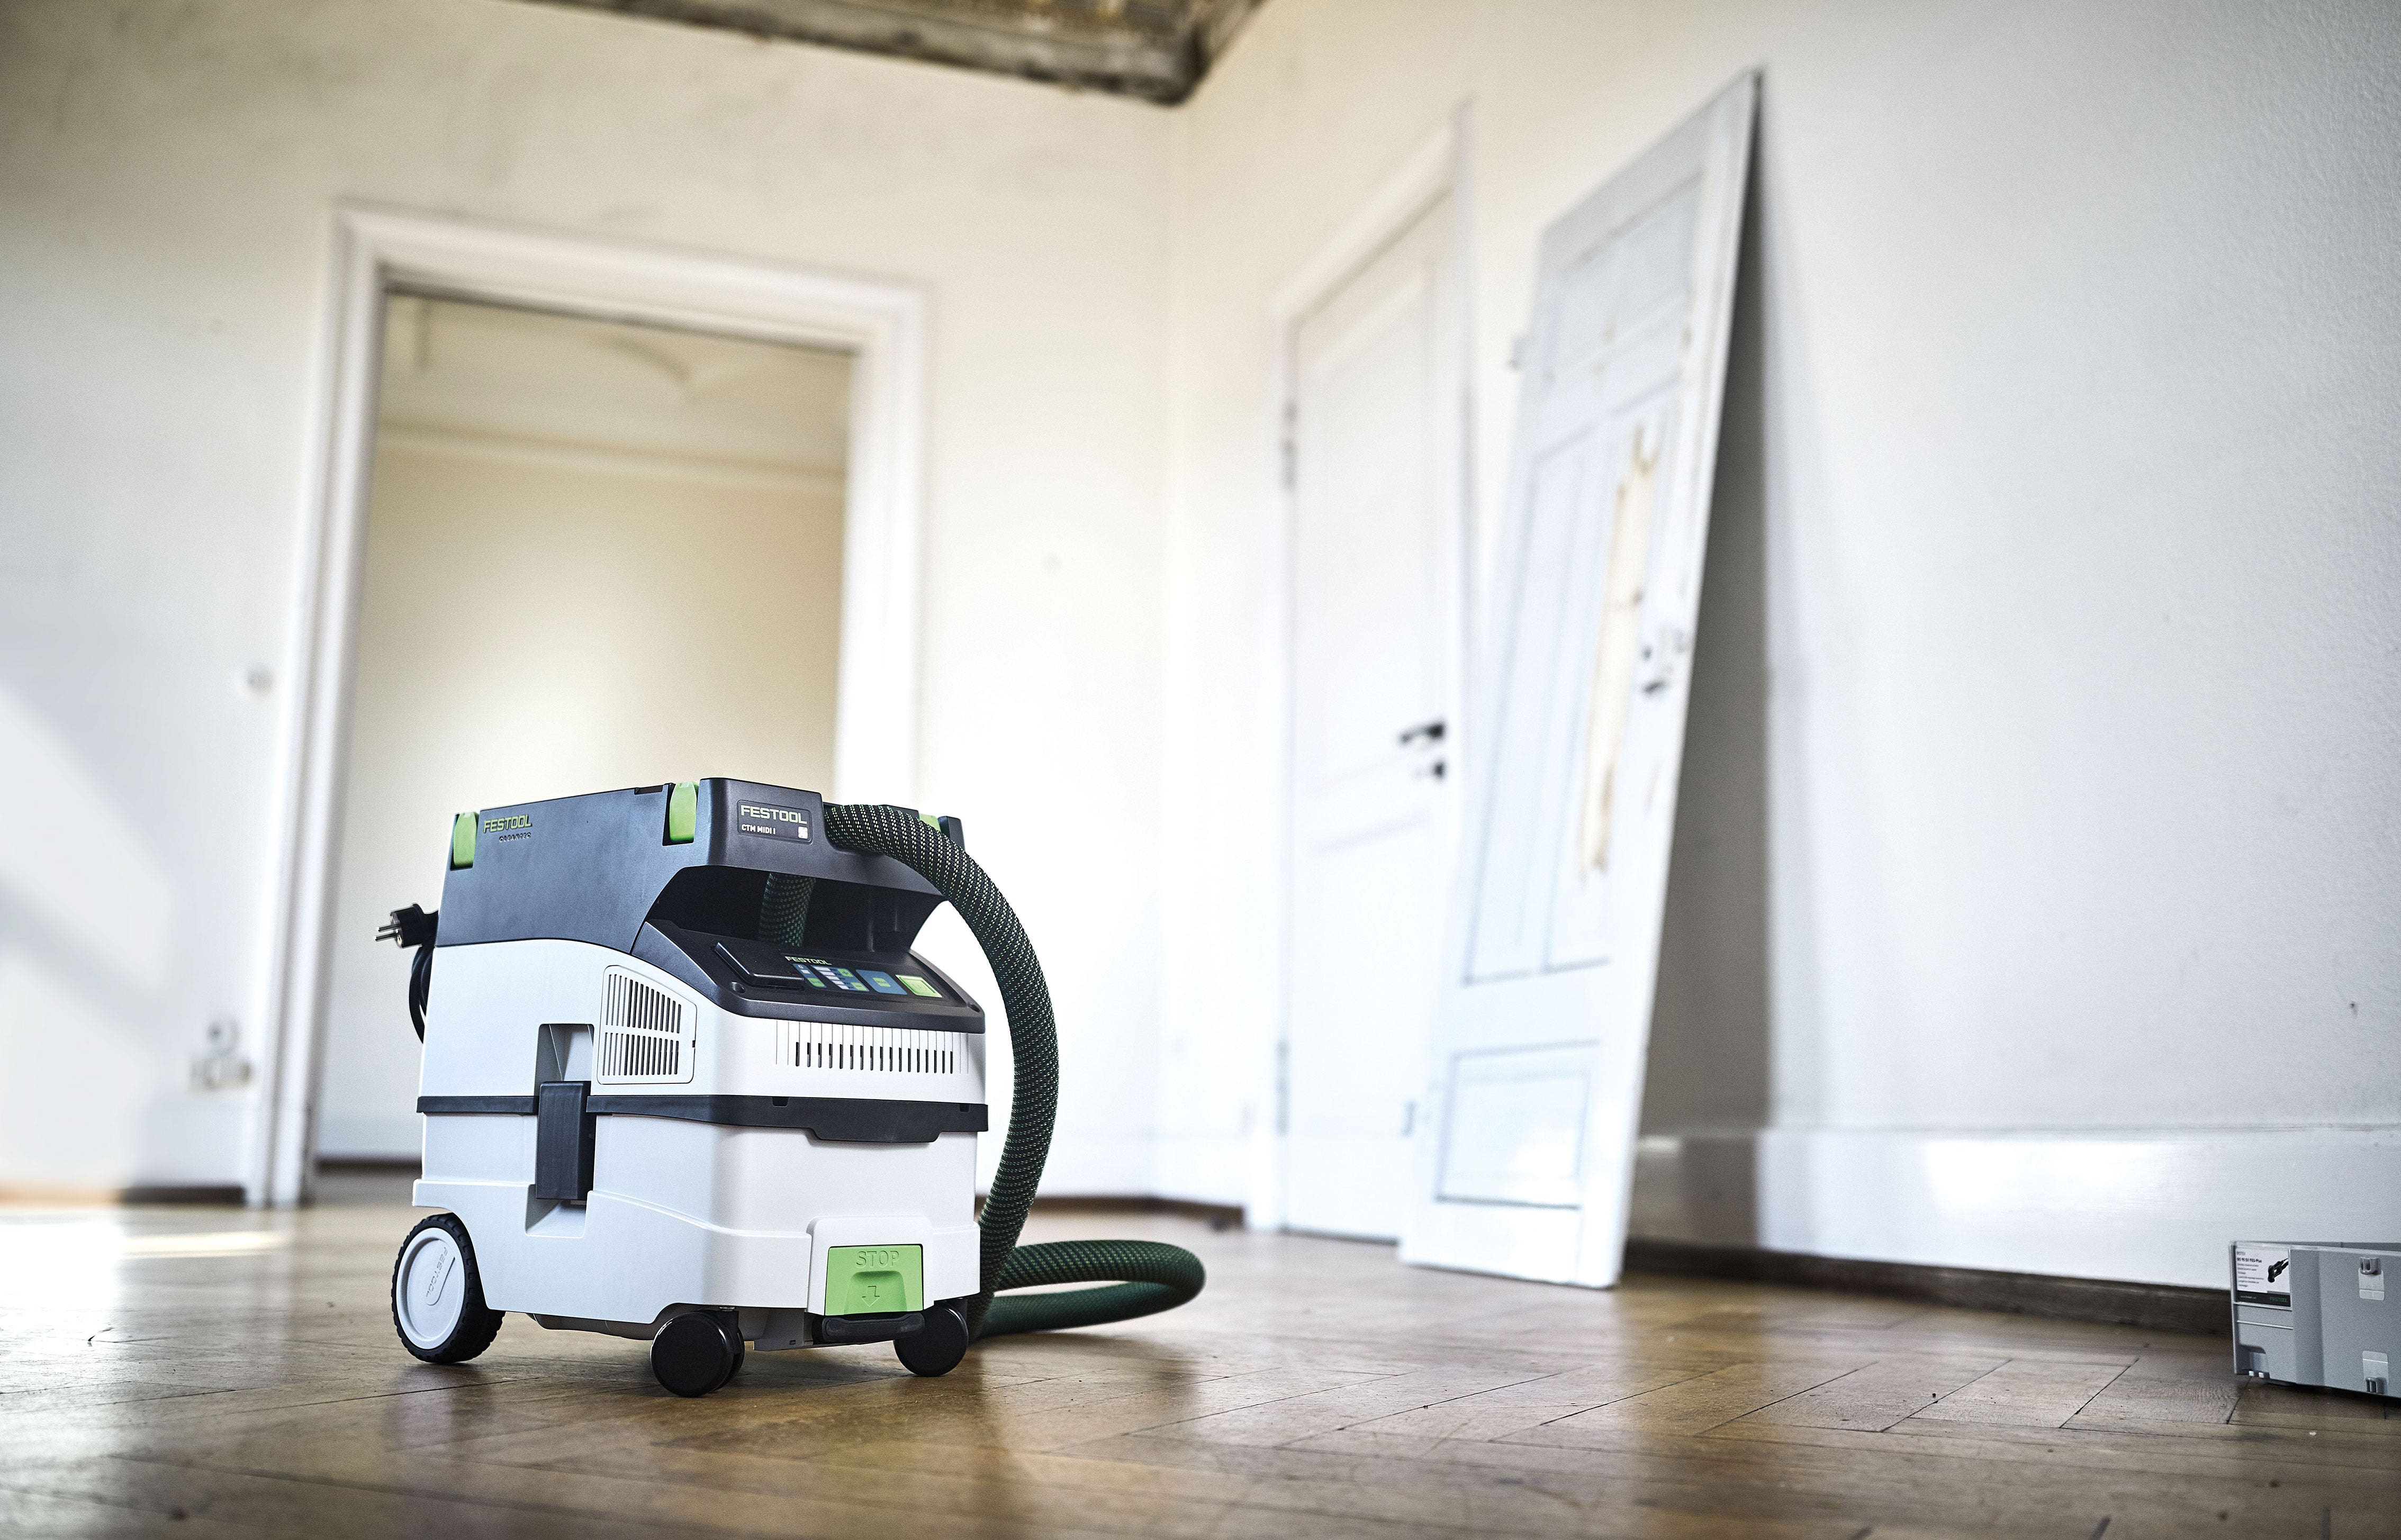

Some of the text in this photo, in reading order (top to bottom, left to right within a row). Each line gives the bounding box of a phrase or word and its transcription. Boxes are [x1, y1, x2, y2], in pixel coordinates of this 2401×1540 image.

[483, 814, 531, 833] FESTOOL
[741, 805, 807, 825] FESTOOL
[499, 832, 531, 843] CLEANTEC
[741, 824, 756, 832] CTM
[757, 826, 772, 835] MIDI
[784, 956, 832, 965] FESTOOL
[856, 1251, 899, 1268] STOP
[426, 1247, 448, 1297] FESTOOL
